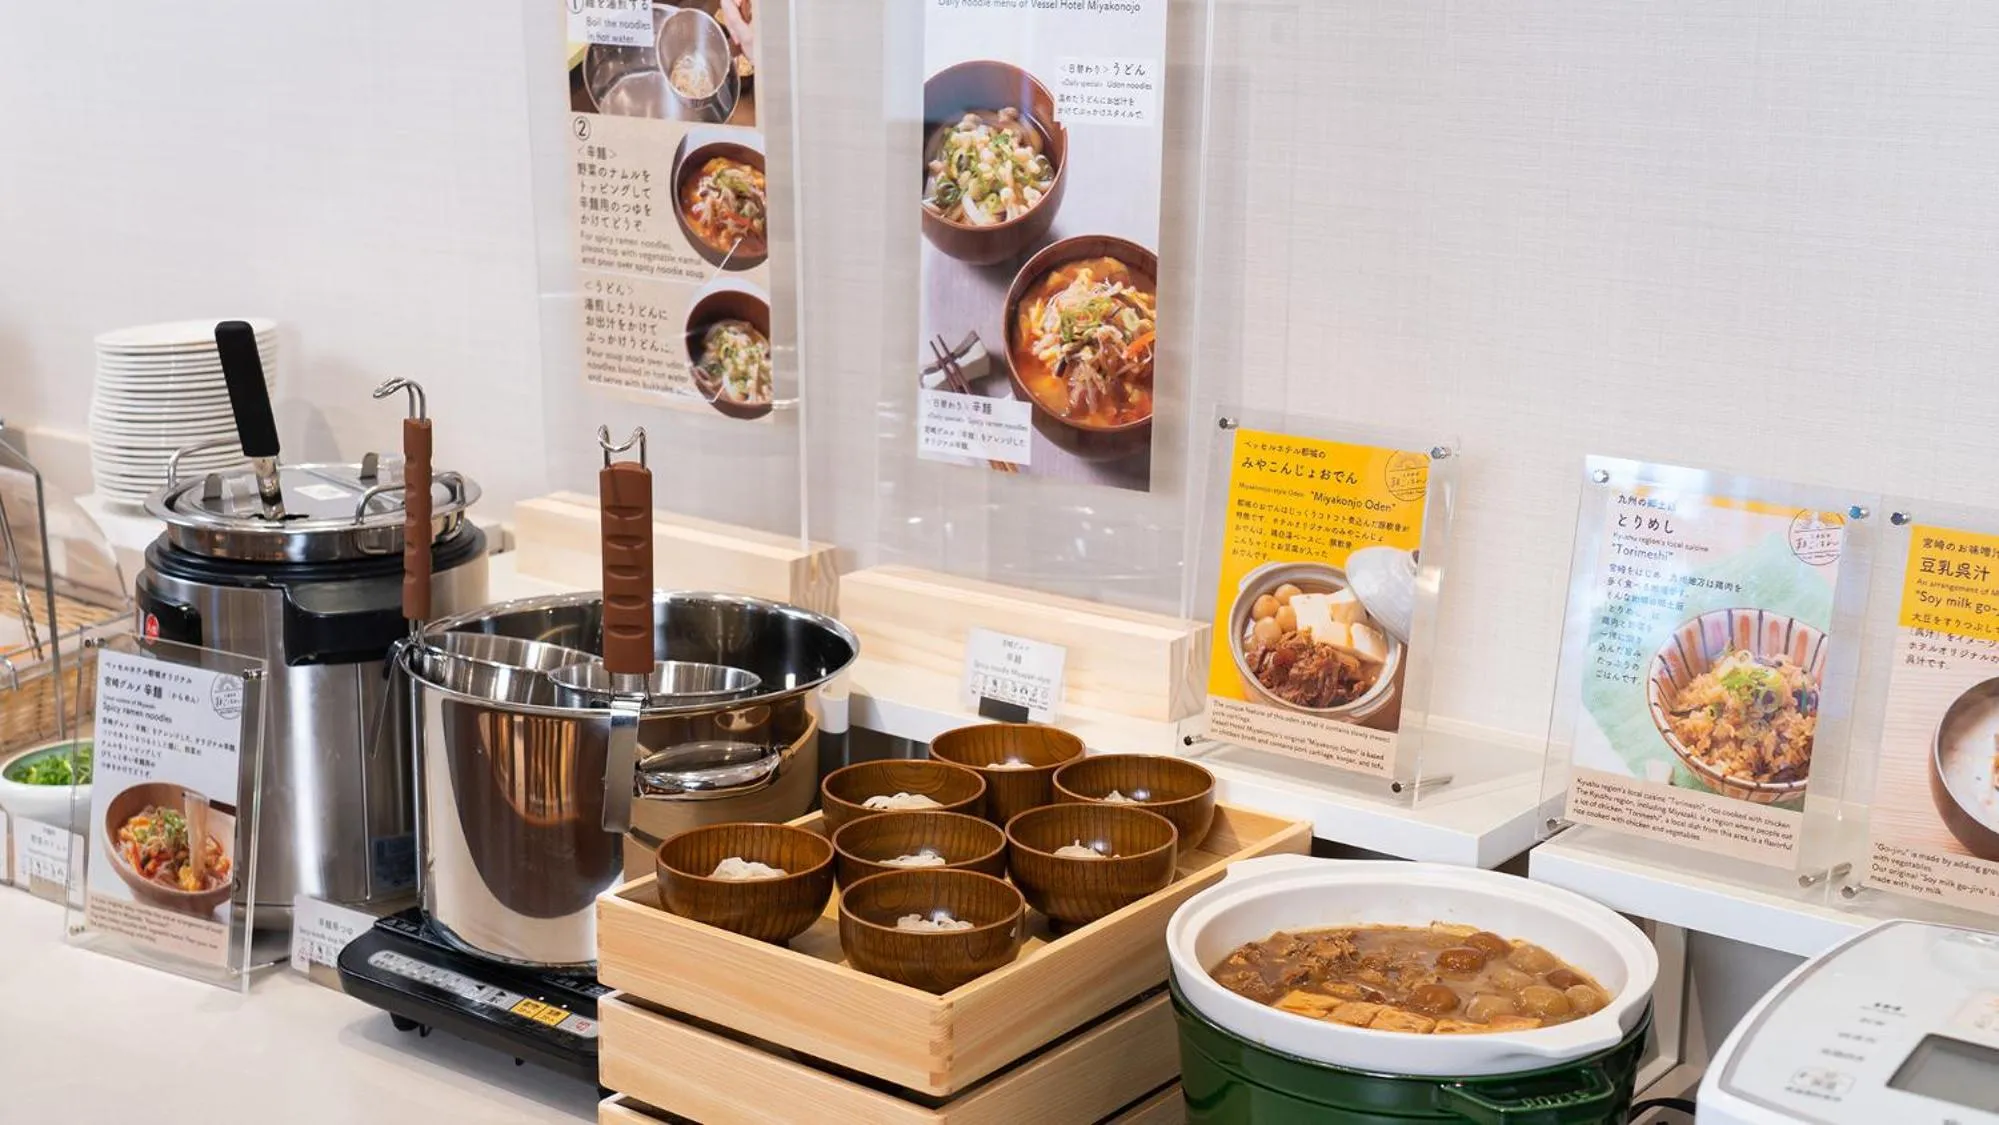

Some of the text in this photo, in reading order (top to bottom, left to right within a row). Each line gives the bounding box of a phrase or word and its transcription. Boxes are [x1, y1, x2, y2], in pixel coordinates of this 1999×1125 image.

[1019, 0, 1029, 8] of
[1031, 0, 1057, 9] Vessel
[1060, 0, 1085, 10] Hotel
[1087, 1, 1140, 14] Miyakonojo
[604, 20, 617, 28] the
[619, 20, 651, 31] noodles
[596, 32, 610, 41] hot
[577, 162, 651, 183] 野菜のナムルを
[581, 180, 651, 200] トッピングして
[586, 315, 657, 336] お出汁をかけて
[1243, 440, 1327, 460] ベッセルホテル都城の
[1241, 456, 1359, 486] みやこんじょおでん
[1618, 513, 1674, 534] とりめし
[1920, 555, 1990, 582] 豆乳呉汁
[1917, 578, 1927, 586] An
[1930, 580, 1979, 594] arrangement
[1946, 595, 1972, 609] milk
[145, 712, 173, 723] noodles
[1367, 751, 1384, 760] based
[1586, 811, 1610, 820] cooked
[1626, 819, 1650, 828] chicken
[1671, 819, 1686, 827] local
[1703, 825, 1718, 833] from
[1720, 829, 1732, 837] this
[1722, 809, 1747, 820] cooked
[1764, 819, 1790, 828] chicken
[1712, 817, 1734, 827] region
[1735, 823, 1755, 831] where
[1756, 827, 1780, 838] people
[1781, 832, 1793, 840] eat
[1873, 854, 1889, 862] with
[1919, 853, 1941, 862] made
[1942, 857, 1951, 867] by
[1953, 861, 1981, 874] adding
[1870, 874, 1891, 884] made
[1893, 879, 1909, 888] with
[1911, 884, 1923, 893] soy
[1872, 863, 1887, 872] Our
[1889, 868, 1919, 879] original
[1939, 879, 1955, 887] milk
